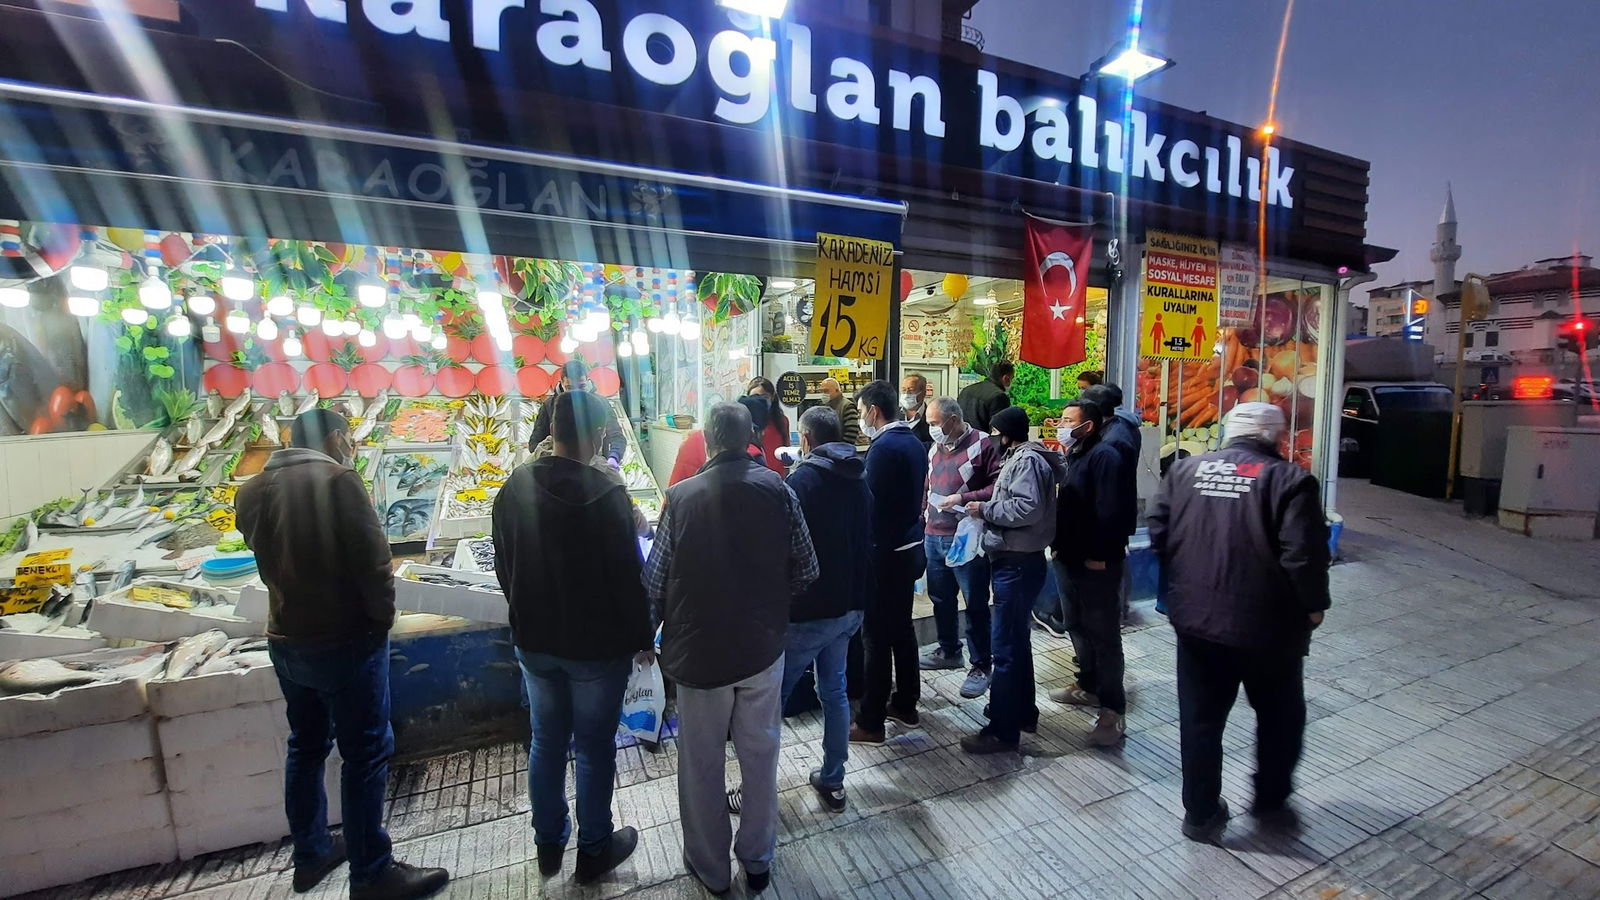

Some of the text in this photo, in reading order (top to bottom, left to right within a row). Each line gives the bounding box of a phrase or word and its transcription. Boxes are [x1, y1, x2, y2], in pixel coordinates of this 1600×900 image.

[254, 0, 945, 138] araoğlan
[1150, 237, 1198, 254] SAĞLIĞINIZ
[1148, 256, 1178, 270] MASKE,
[1179, 259, 1206, 272] HİJYEN
[1148, 268, 1215, 286] SOSYAL MESAFE
[1147, 285, 1215, 302] KURALLARINA
[1163, 302, 1197, 314] UYALIM
[814, 293, 879, 358] 15 KG
[1174, 338, 1183, 346] 1.5
